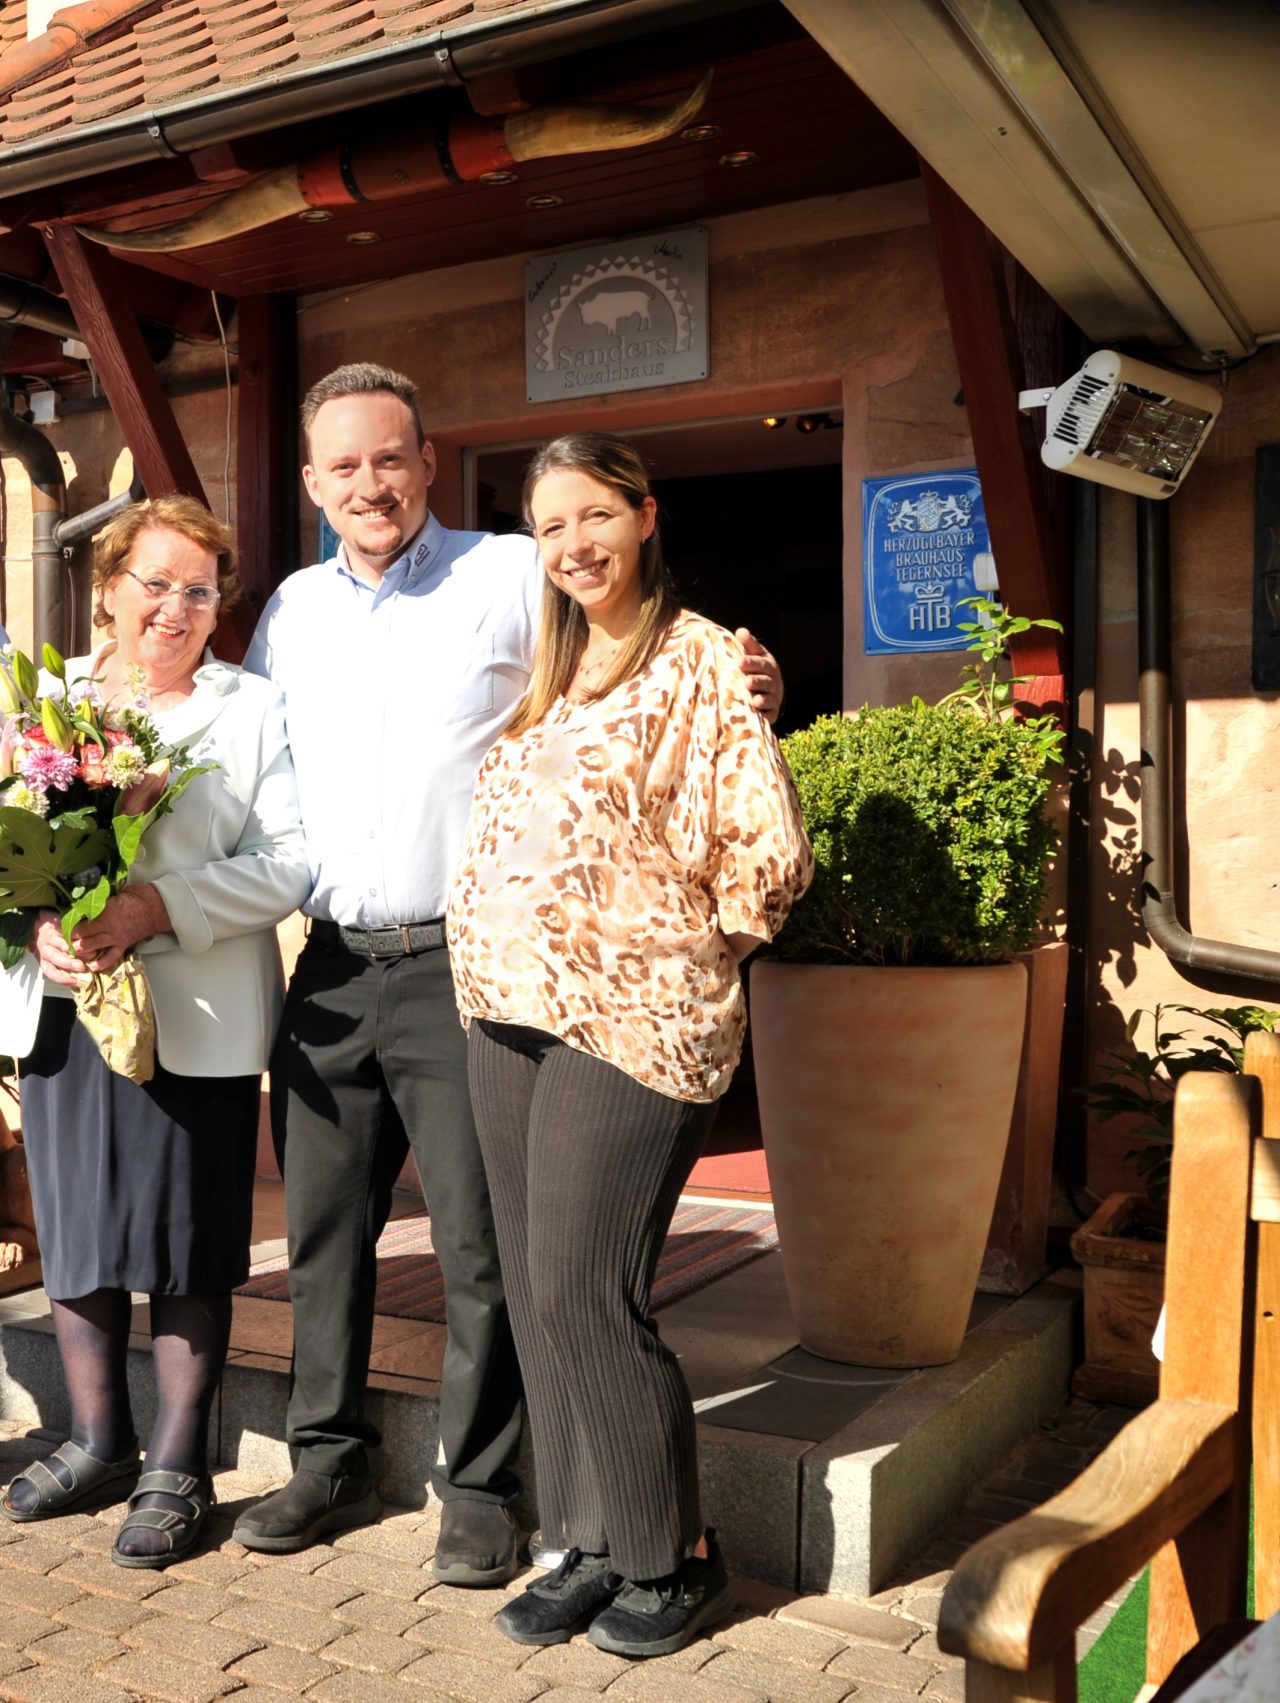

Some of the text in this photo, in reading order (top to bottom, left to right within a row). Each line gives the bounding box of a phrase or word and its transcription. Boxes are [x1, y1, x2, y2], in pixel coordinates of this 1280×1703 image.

[558, 336, 669, 370] Sanders
[564, 362, 664, 388] Steakhaus
[896, 549, 963, 567] BRAUHAUS
[896, 564, 964, 582] TEGERNSEE
[909, 599, 950, 632] HTB
